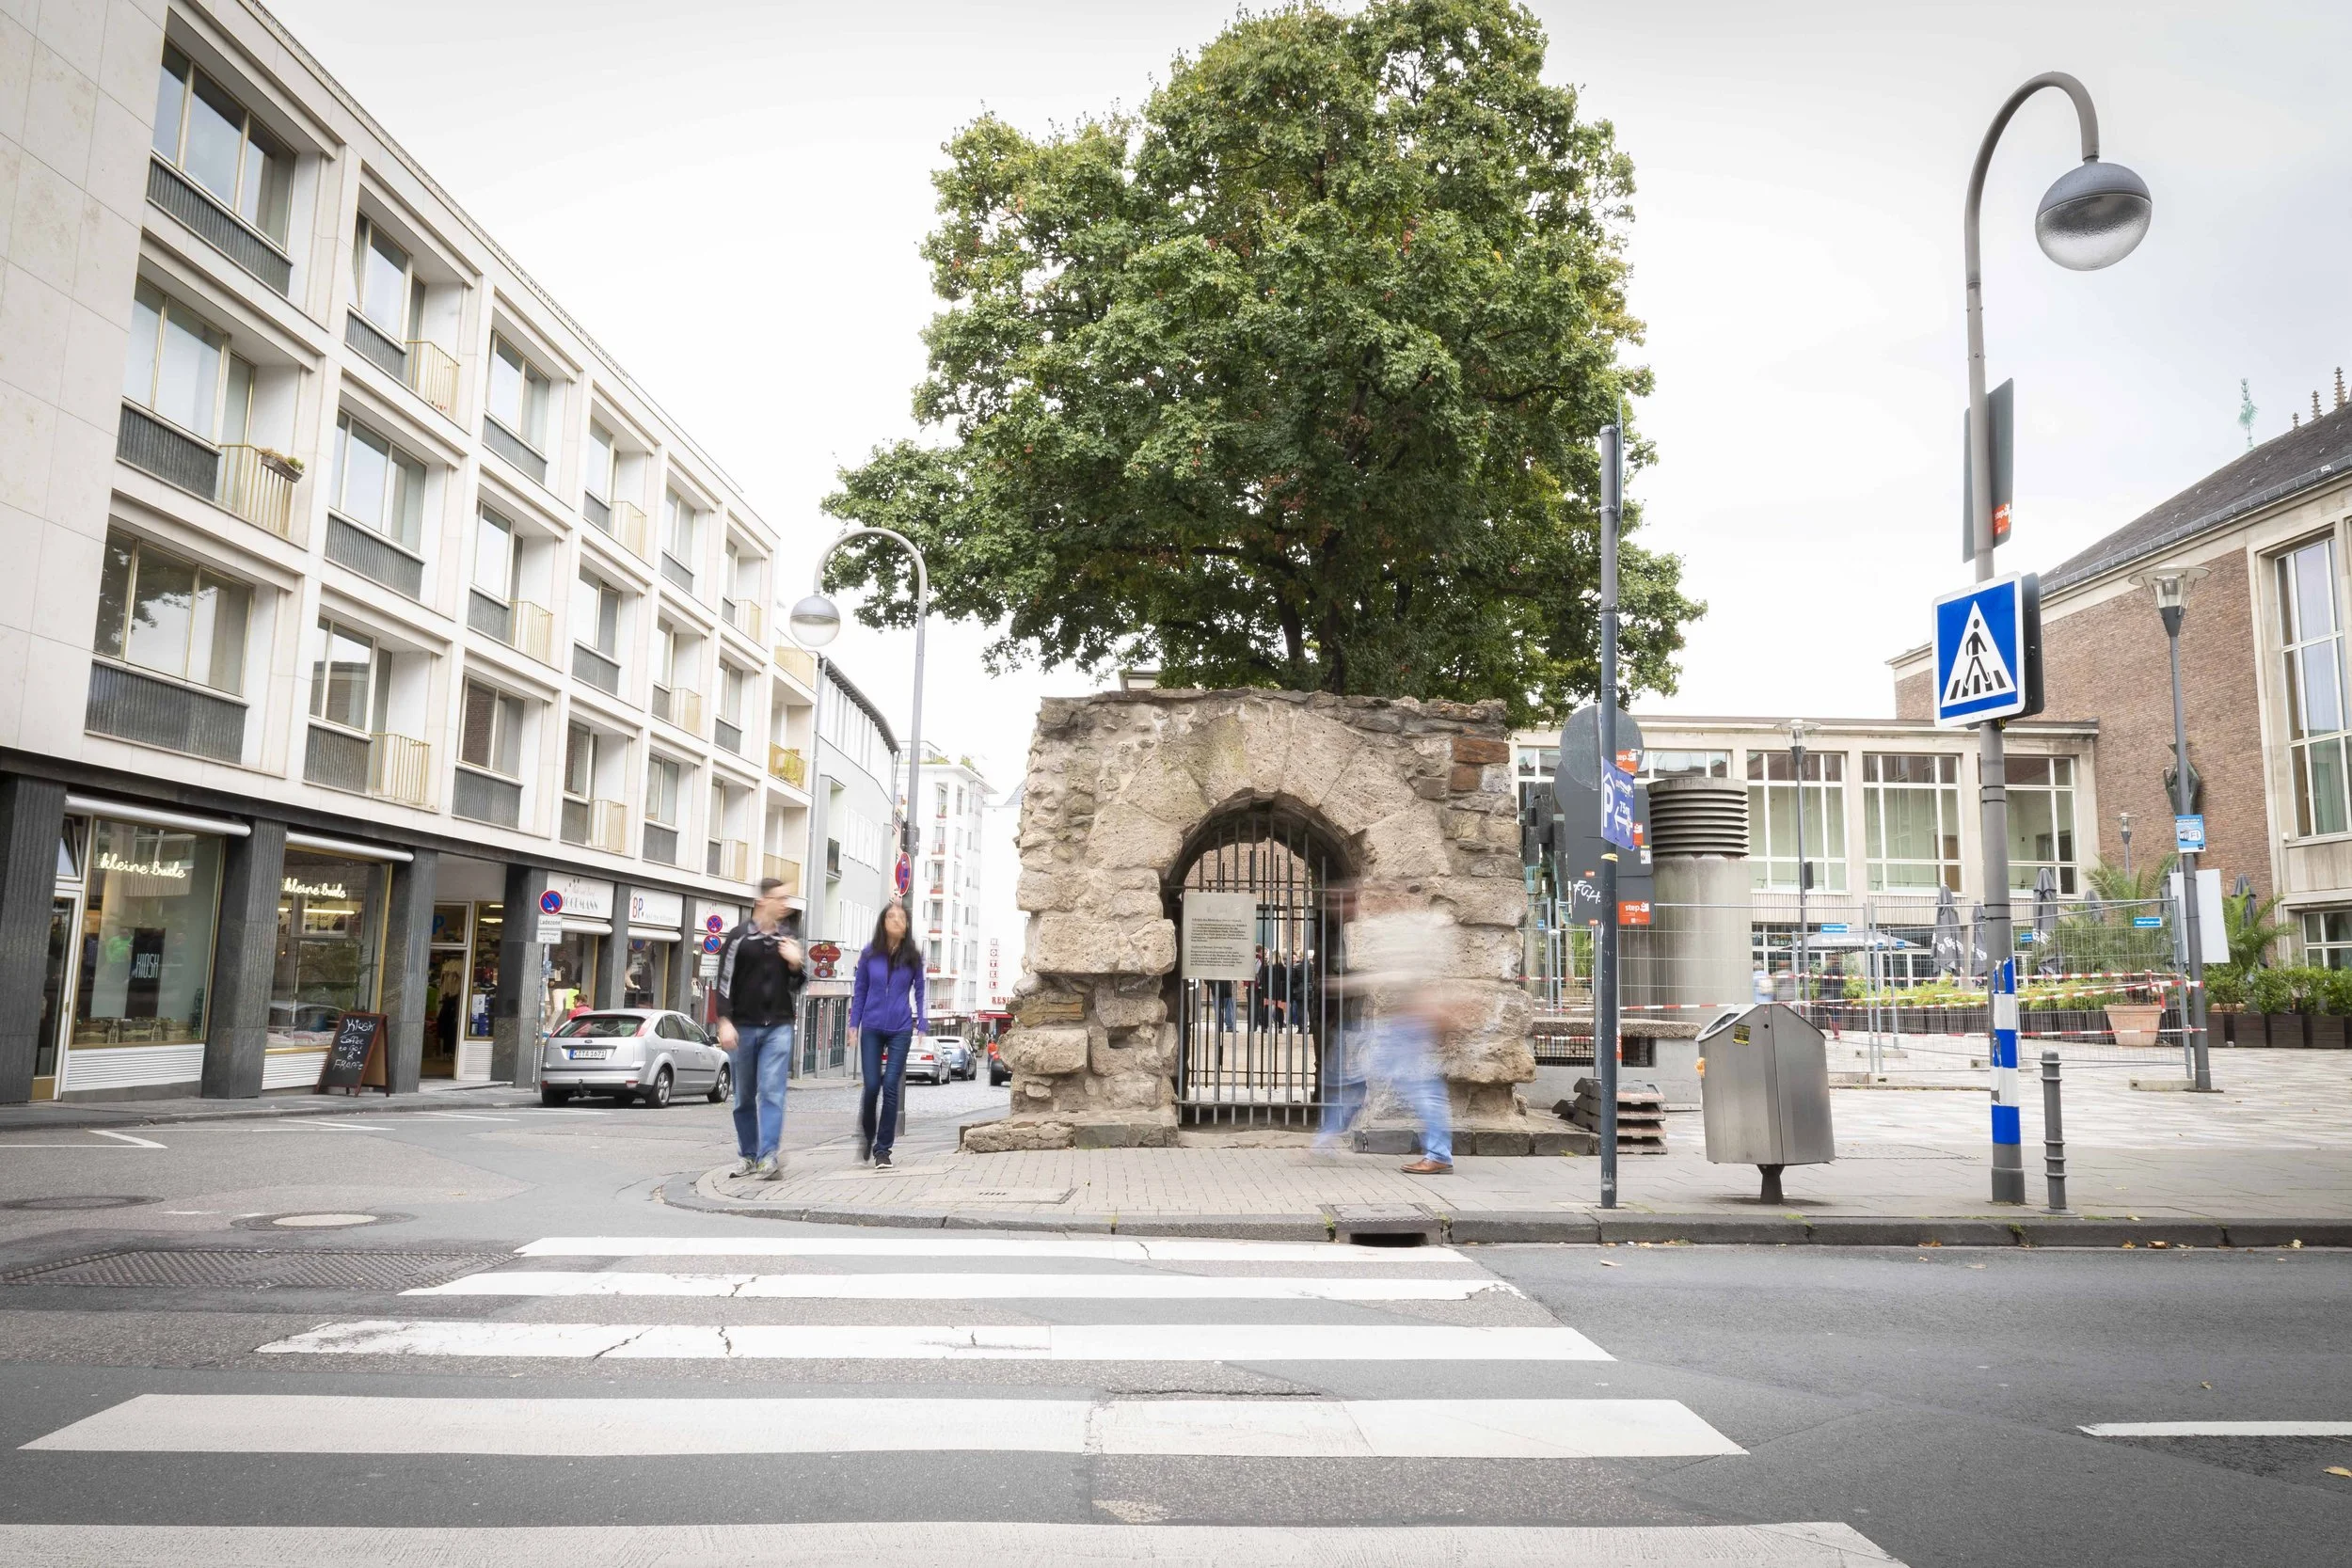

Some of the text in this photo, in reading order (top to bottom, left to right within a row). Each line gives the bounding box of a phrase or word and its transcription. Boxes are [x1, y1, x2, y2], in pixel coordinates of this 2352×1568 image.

[1604, 784, 1613, 829] P
[100, 852, 186, 879] kleine Bude
[284, 877, 347, 898] kleine Bude
[135, 953, 160, 979] KIOSK
[343, 1018, 376, 1034] Kiosk
[339, 1035, 365, 1045] Coffee
